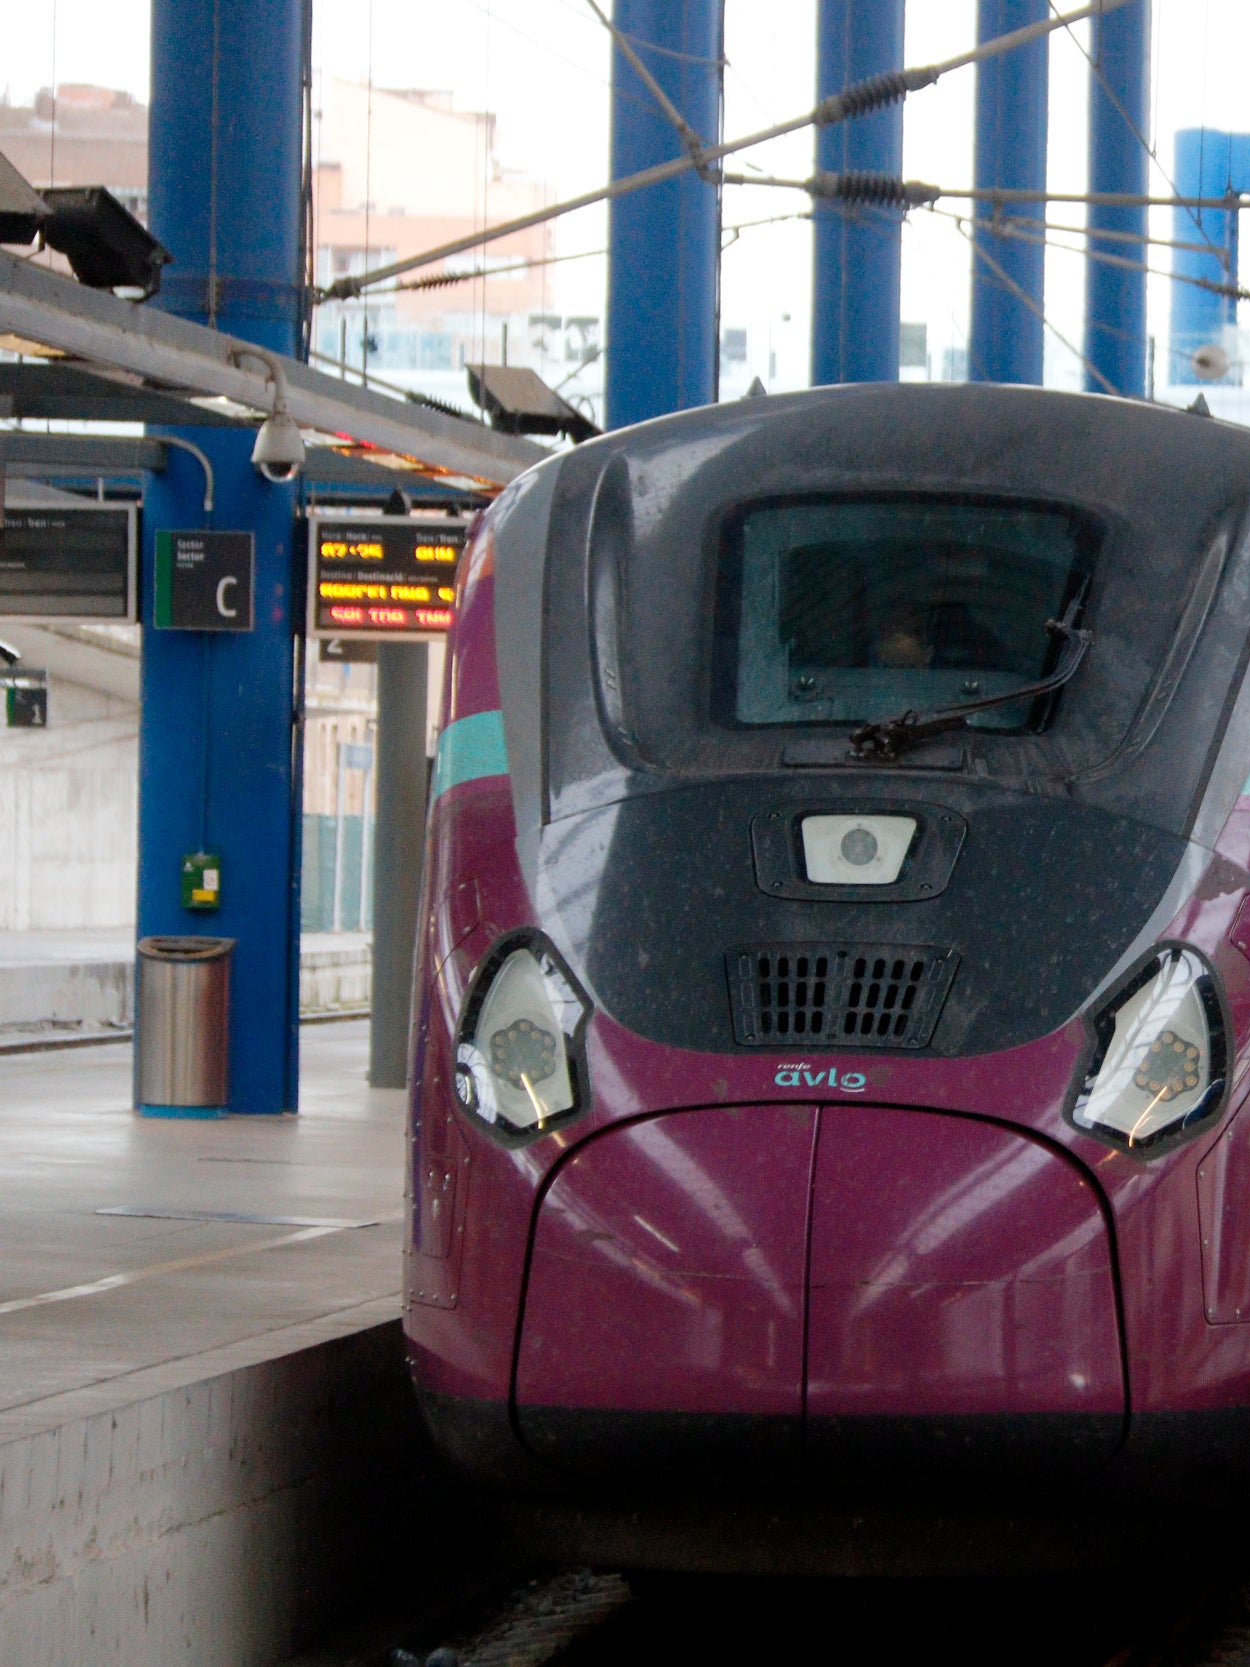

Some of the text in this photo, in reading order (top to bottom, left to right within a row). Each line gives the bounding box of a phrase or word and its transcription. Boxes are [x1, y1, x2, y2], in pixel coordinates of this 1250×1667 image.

[177, 539, 204, 549] Sector
[176, 551, 205, 561] Sector
[216, 575, 238, 618] C
[774, 1067, 867, 1090] avlo
